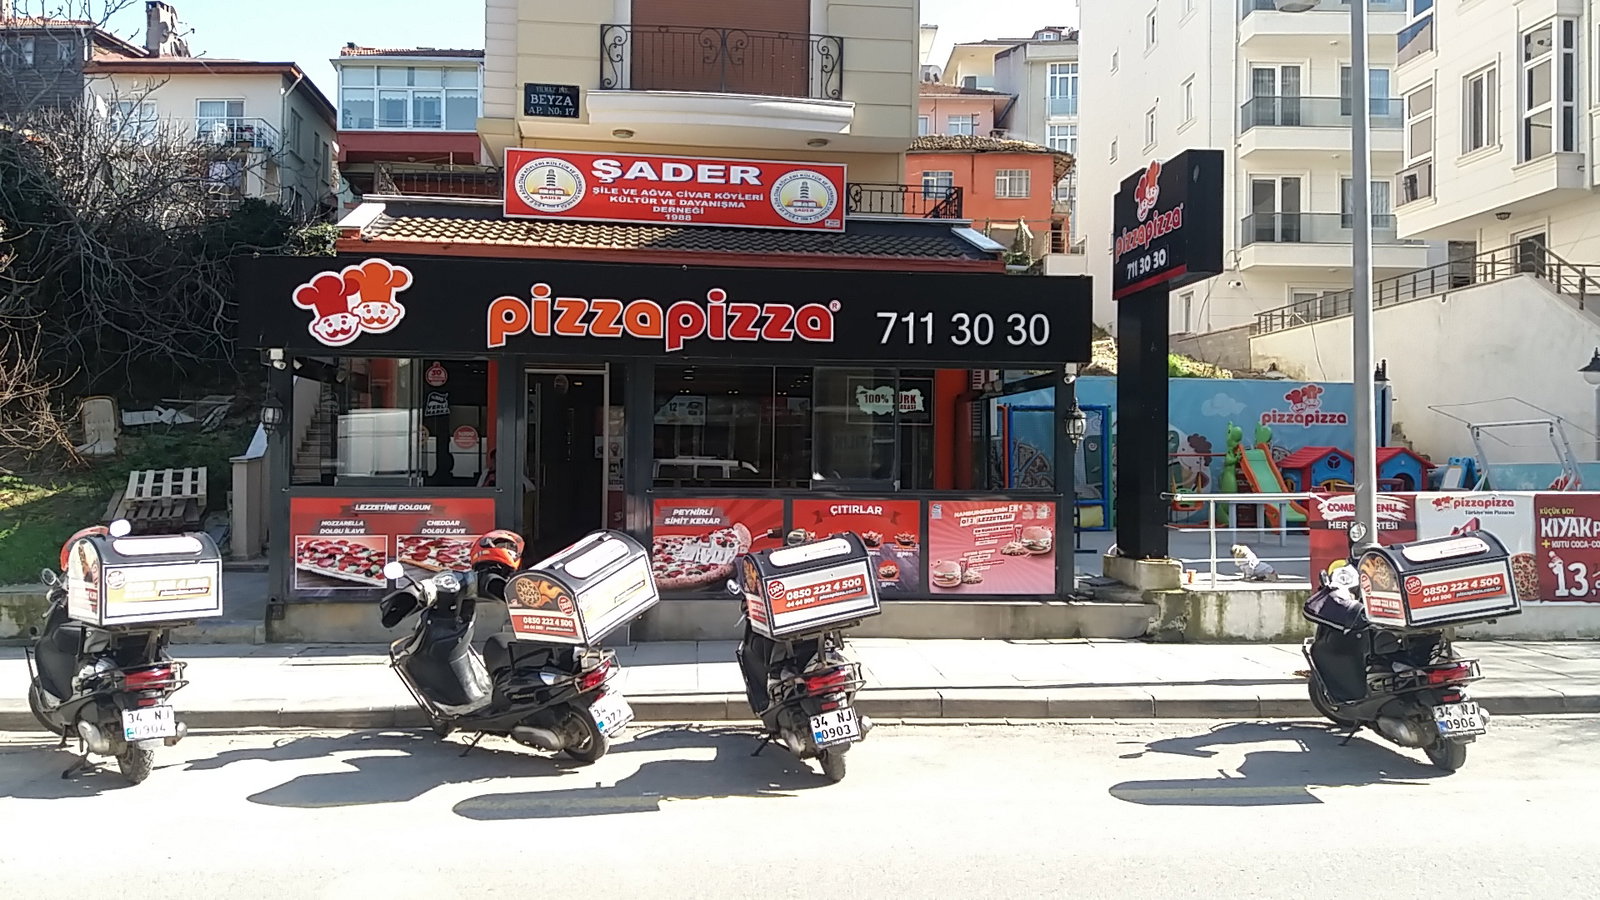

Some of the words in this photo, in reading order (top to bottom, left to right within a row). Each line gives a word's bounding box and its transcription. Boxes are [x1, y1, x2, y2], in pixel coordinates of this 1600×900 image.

[530, 93, 573, 106] BEYZA
[528, 106, 543, 114] AP.
[565, 108, 575, 116] 17
[592, 158, 764, 186] ŞADER
[592, 185, 619, 197] ŞİLE
[622, 187, 639, 196] VE
[640, 186, 674, 198] AĞVA
[676, 188, 712, 199] CİVAR
[714, 190, 764, 202] KÖYLERİ
[609, 195, 659, 206] KÜLTÜR
[660, 197, 678, 206] VE
[679, 198, 746, 209] DAYANIŞMA
[652, 204, 705, 215] DERNEĞİ
[664, 213, 693, 222] 1988
[1127, 260, 1139, 281] 711
[1139, 256, 1152, 274] 30
[1153, 247, 1166, 269] 30
[876, 311, 933, 346] 711
[950, 312, 994, 347] 30
[1006, 312, 1051, 348] 30
[1261, 409, 1348, 428] pizzapizza
[398, 503, 431, 512] DOLGUN
[1327, 502, 1356, 513] COMB
[1453, 497, 1515, 509] pizzapizza
[672, 507, 714, 517] PEYNİRLİ
[829, 504, 883, 517] ÇITIRLAR
[1539, 507, 1561, 517] KÜÇÜK
[426, 519, 460, 527] CHEDDAR
[691, 516, 721, 526] KENAR
[1328, 521, 1348, 529] HER
[1540, 516, 1592, 538] KIYAK
[1552, 540, 1569, 548] KUTU
[786, 588, 812, 600] 0850
[814, 584, 831, 594] 222
[833, 582, 841, 590] 4
[842, 578, 861, 589] 500
[1422, 585, 1448, 597] 0850
[1450, 582, 1469, 592] 222
[1470, 580, 1479, 588] 4
[1480, 576, 1501, 587] 500
[594, 706, 606, 718] 34
[1436, 706, 1452, 718] 34
[1460, 704, 1476, 716] NJ
[128, 712, 143, 724] 34
[813, 717, 828, 729] 34
[837, 707, 853, 722] NJ
[1445, 717, 1476, 730] 0906
[822, 723, 852, 742] 0903
